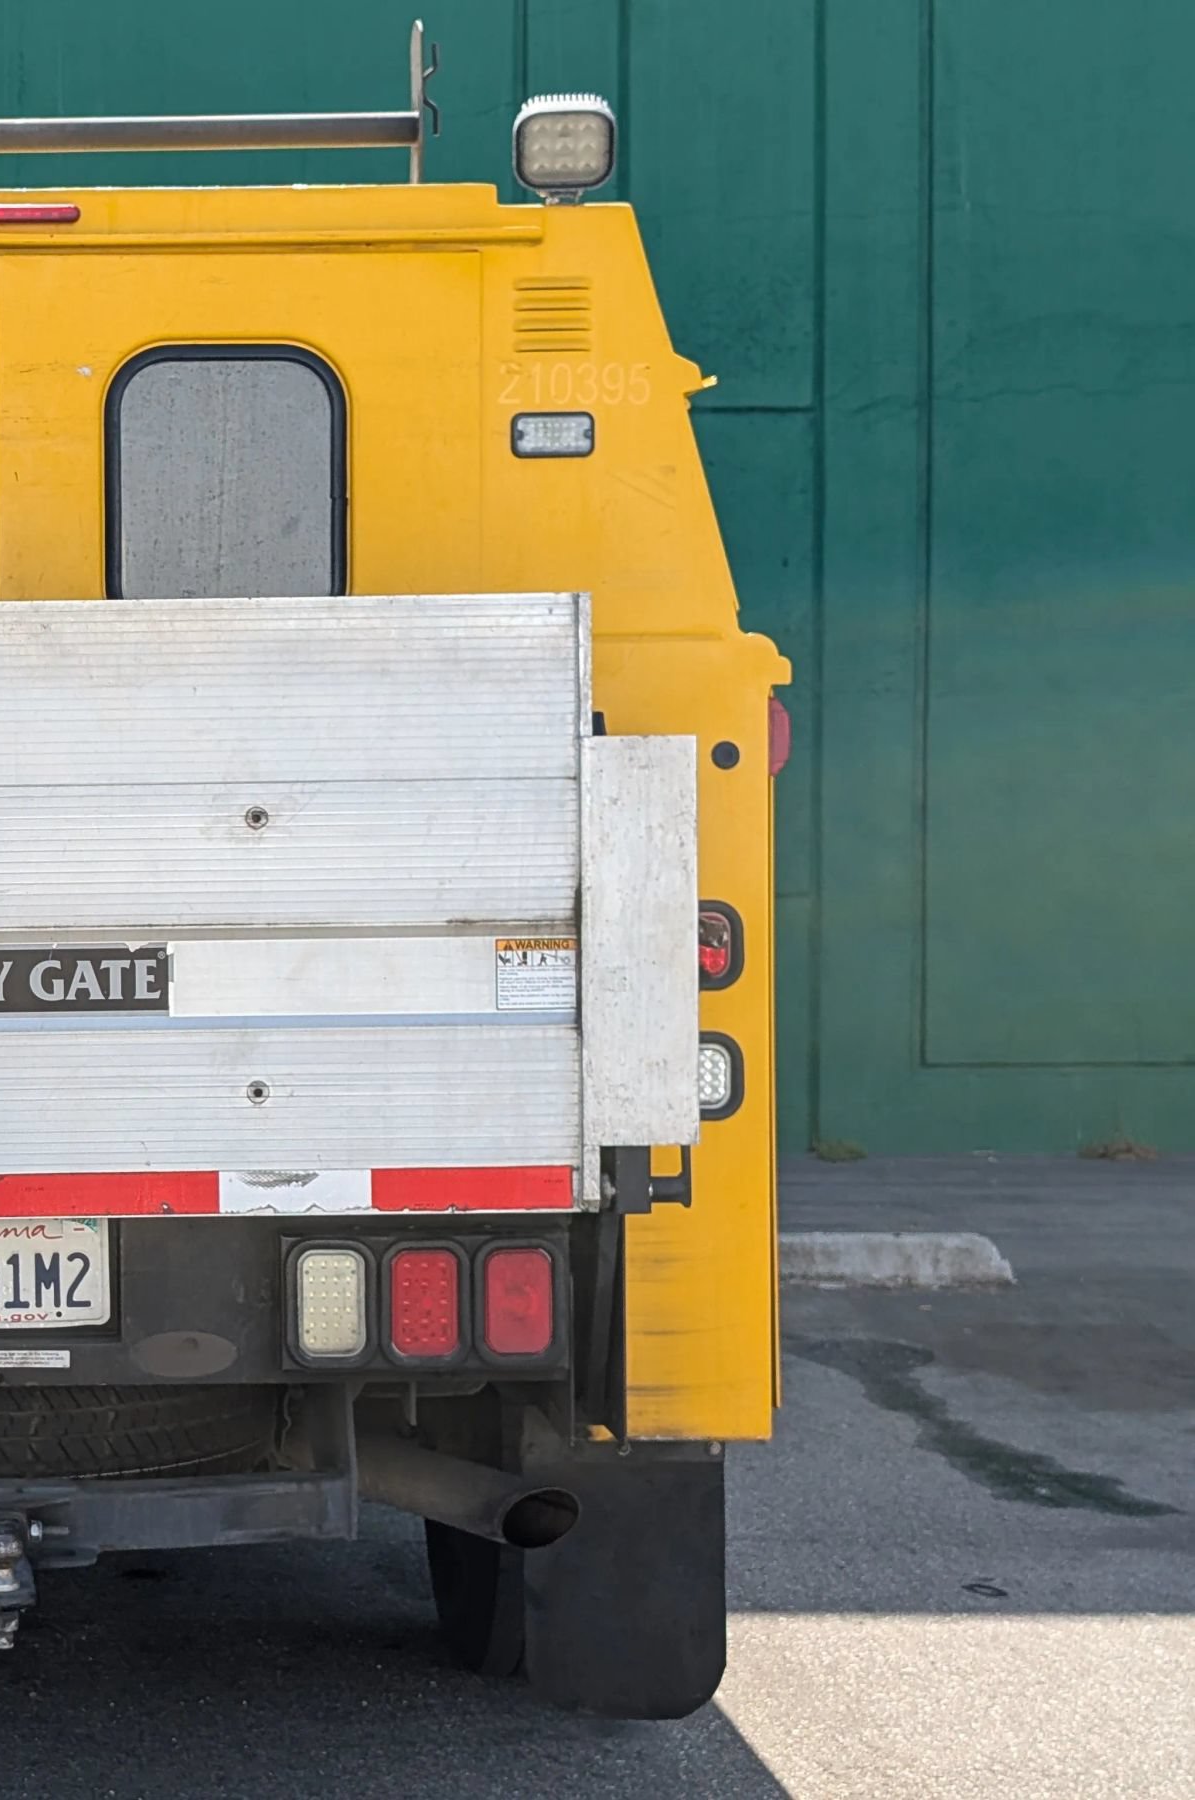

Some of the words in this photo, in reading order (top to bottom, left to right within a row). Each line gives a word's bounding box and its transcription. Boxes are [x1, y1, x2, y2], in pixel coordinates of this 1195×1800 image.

[498, 362, 651, 405] 210395
[514, 940, 570, 950] WARNING
[29, 959, 162, 1001] GATE
